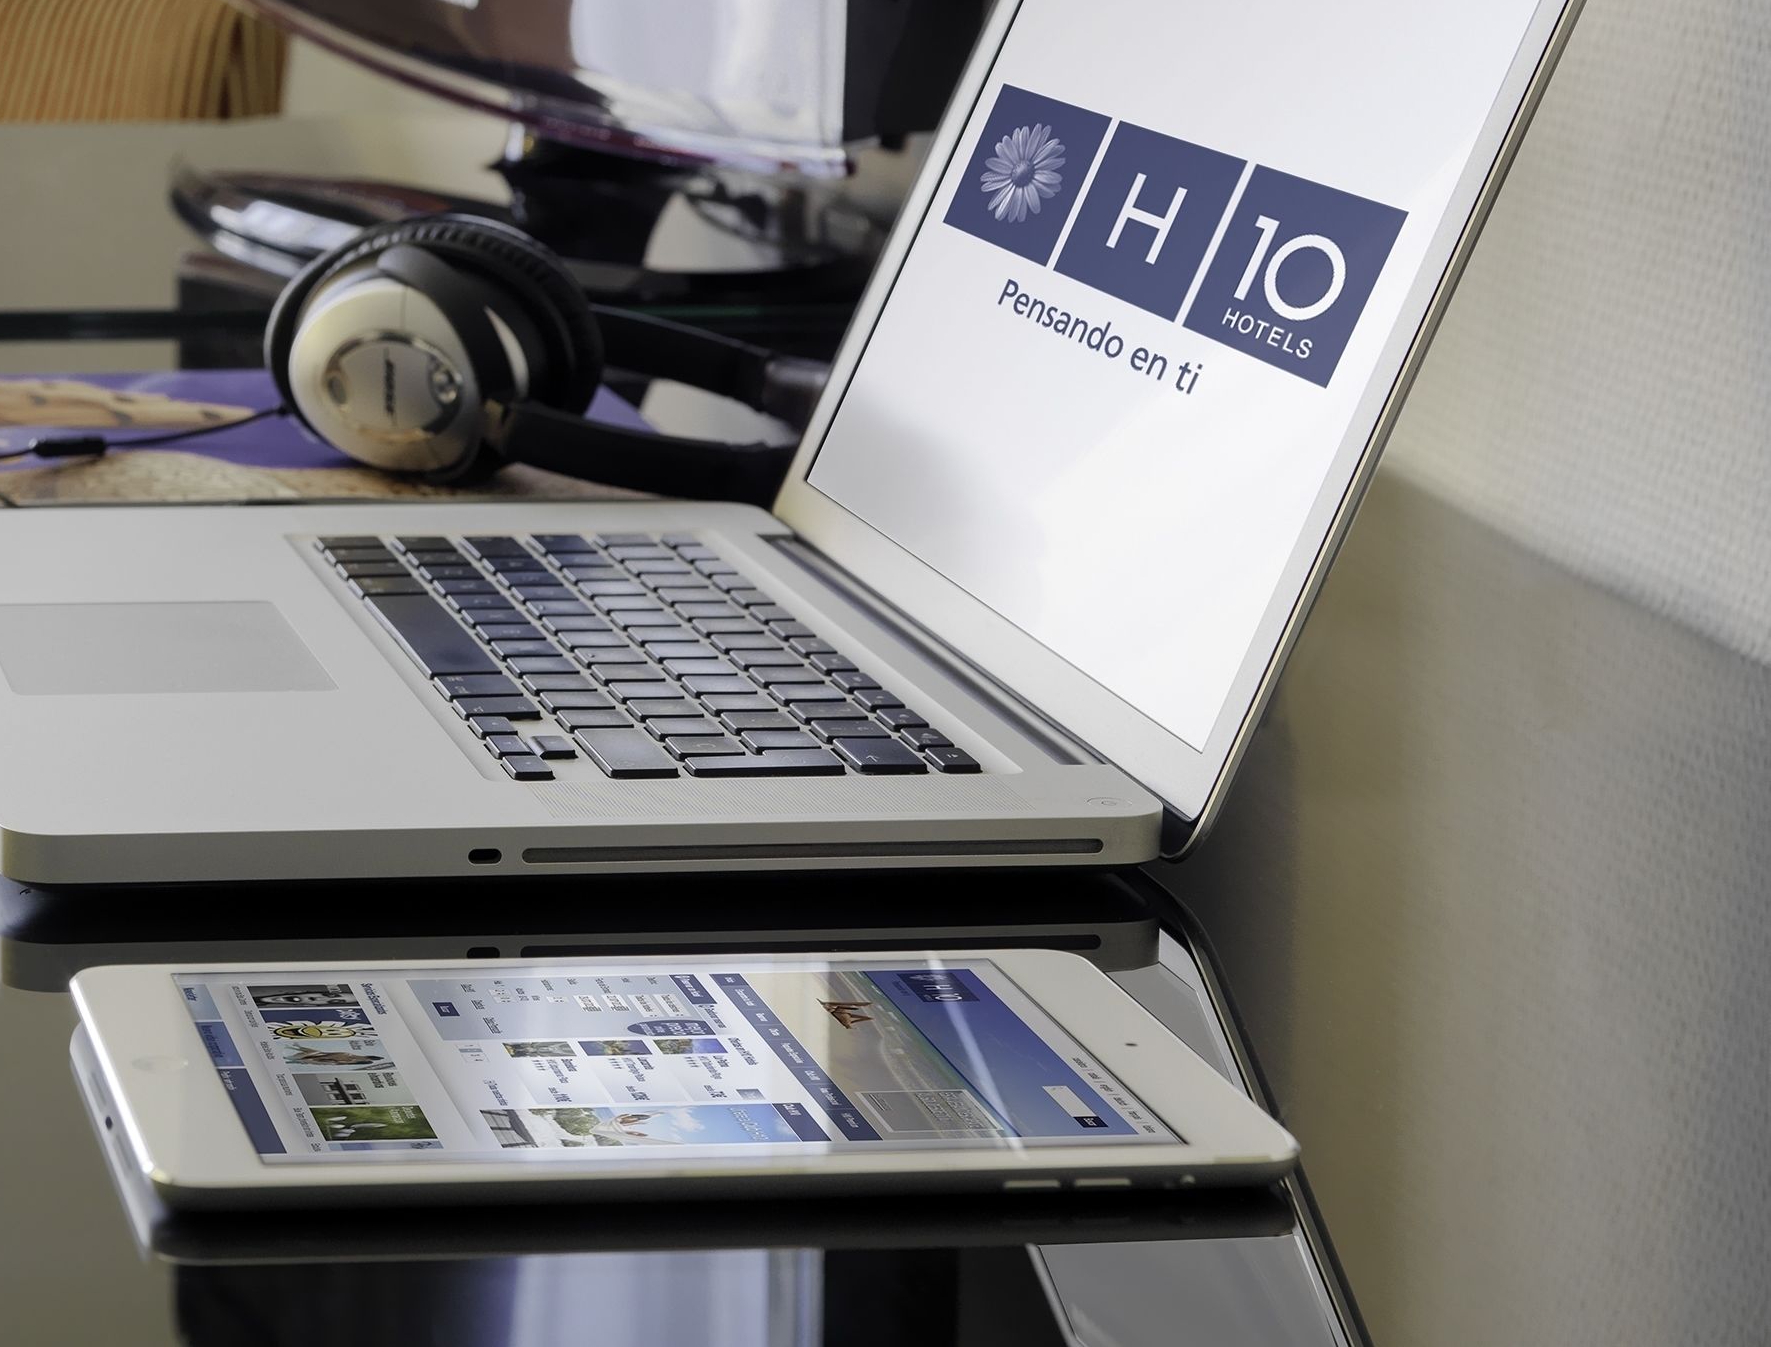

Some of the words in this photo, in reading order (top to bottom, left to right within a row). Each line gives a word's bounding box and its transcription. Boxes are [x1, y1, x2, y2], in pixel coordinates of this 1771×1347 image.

[1233, 214, 1347, 321] 10
[997, 278, 1124, 359] Pensando
[1130, 346, 1168, 381] en
[1175, 361, 1203, 394] ti
[1222, 307, 1313, 359] HOTELS
